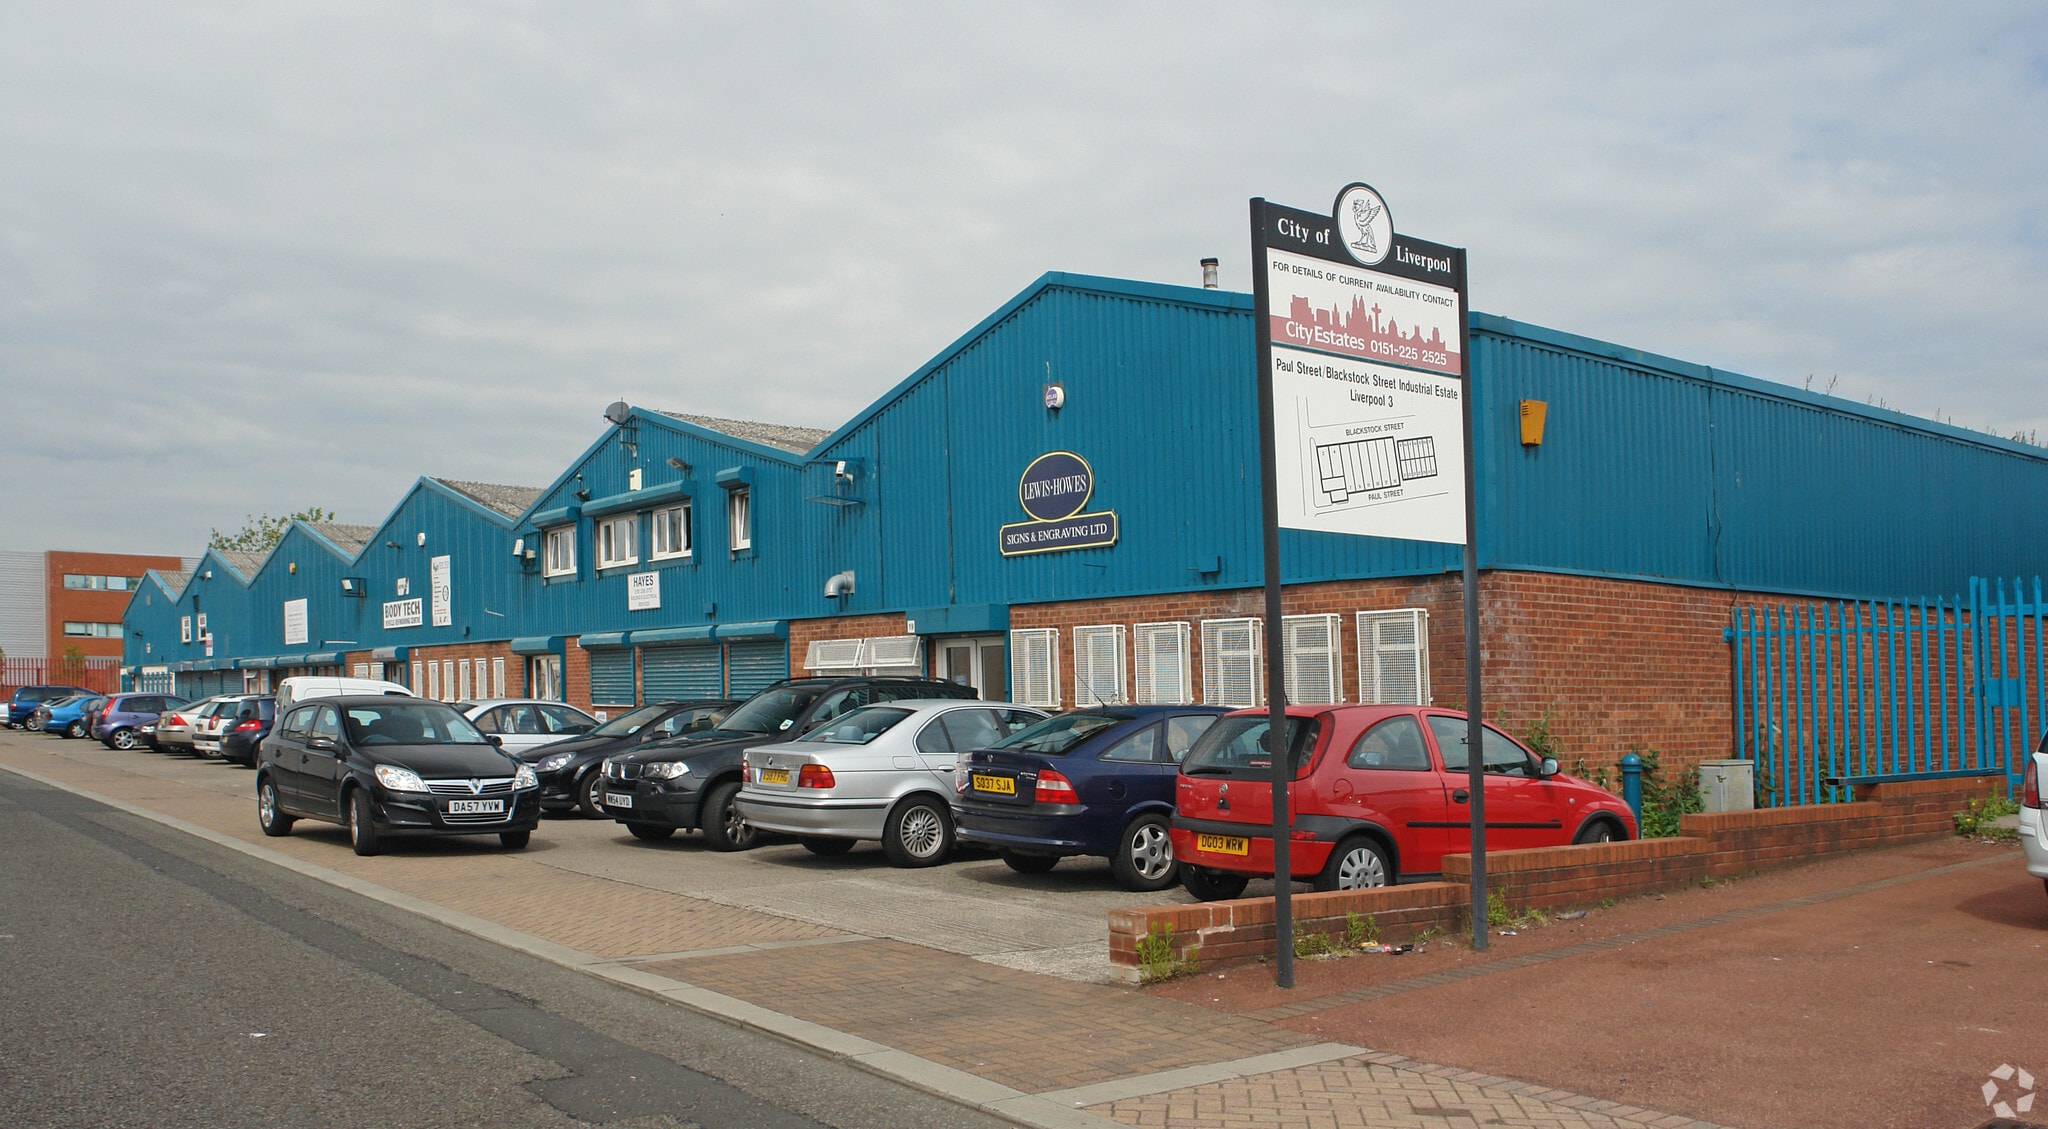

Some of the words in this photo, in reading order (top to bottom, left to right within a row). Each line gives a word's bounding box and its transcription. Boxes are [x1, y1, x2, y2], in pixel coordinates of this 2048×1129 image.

[1277, 218, 1309, 244] City
[1316, 229, 1330, 245] of
[1396, 245, 1452, 273] Liverpool
[1273, 261, 1290, 273] FOR
[1292, 266, 1323, 279] DETAILS
[1326, 272, 1337, 282] OF
[1339, 275, 1373, 290] CURRENT
[1376, 284, 1420, 300] AVAILABILITY
[1422, 293, 1453, 308] CONTACT
[1370, 340, 1418, 360] 0151-225
[1422, 350, 1447, 365] 2525
[1276, 358, 1294, 373] Paul
[1372, 375, 1397, 390] Street
[1399, 379, 1433, 396] Industrial
[1434, 385, 1458, 400] Estate
[1350, 389, 1386, 407] Liverpool
[1388, 396, 1394, 408] 3
[1346, 425, 1382, 436] BLACKSTOCK
[1384, 422, 1404, 432] STREET
[1368, 493, 1382, 501] PAUL
[1383, 489, 1404, 498] STREET
[1006, 533, 1030, 545] SIGNS
[1030, 532, 1037, 542] &
[1038, 525, 1088, 542] ENGRAVING
[1090, 523, 1108, 536] LTD
[633, 575, 654, 588] HAYES
[385, 603, 402, 618] BODY
[403, 601, 420, 616] TECH
[996, 779, 1011, 791] SJA
[453, 801, 479, 812] DA57
[481, 801, 500, 811] YVW
[1201, 835, 1224, 849] DG03
[1225, 838, 1244, 851] WRW
